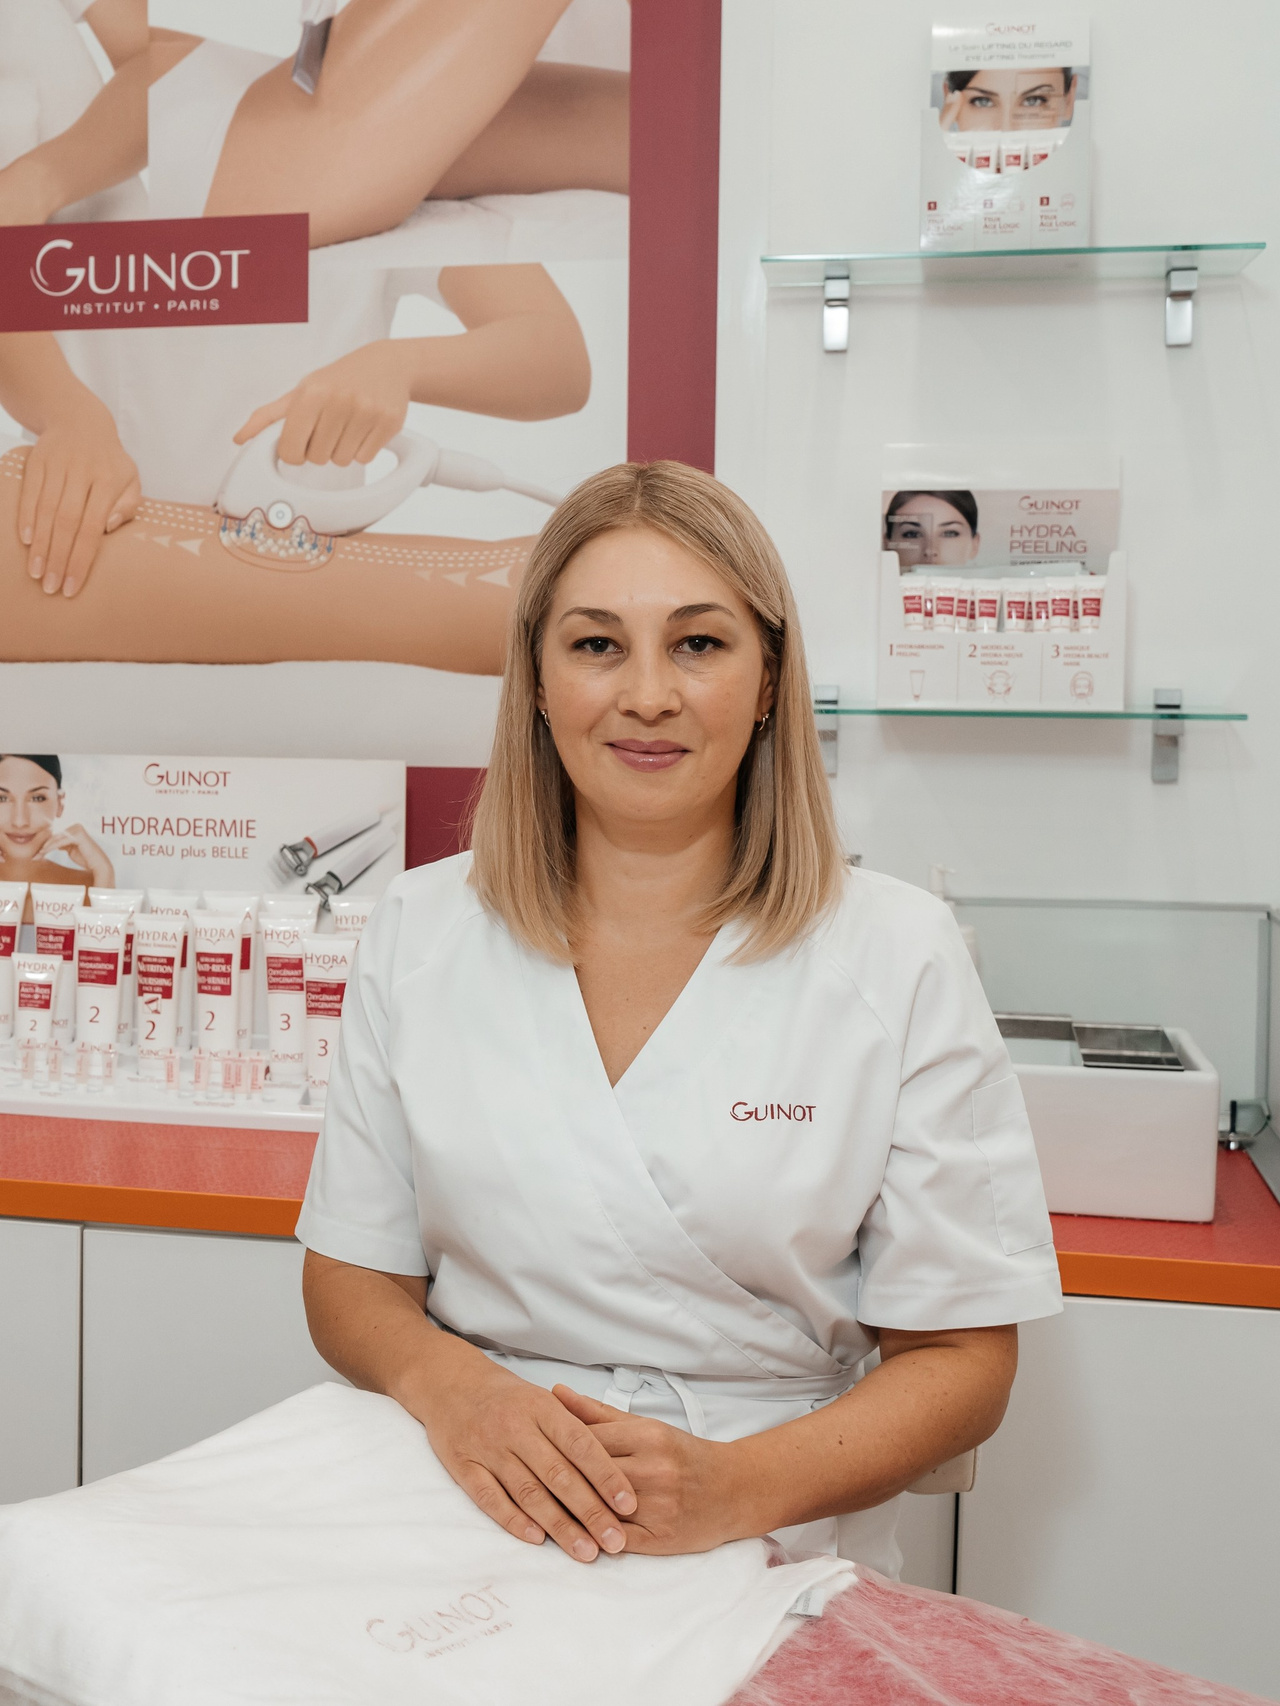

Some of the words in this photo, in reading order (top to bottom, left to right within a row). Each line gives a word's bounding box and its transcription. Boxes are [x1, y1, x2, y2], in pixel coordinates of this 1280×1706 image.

[30, 239, 251, 297] GUINOT
[64, 301, 146, 316] INSTITUT
[167, 299, 220, 313] PARIS
[1019, 495, 1081, 511] GUINOT
[1010, 524, 1077, 538] HYDRA
[1009, 539, 1087, 554] PEELING
[968, 643, 977, 658] 2
[1051, 644, 1060, 658] 3
[142, 763, 231, 787] GUINOT
[101, 816, 257, 839] HYDRADERMIE
[122, 844, 136, 856] La
[141, 844, 175, 857] PEAU
[181, 846, 206, 860] plus
[212, 846, 249, 860] BELLE
[335, 915, 367, 925] HYDR
[77, 923, 120, 936] HYDRA
[137, 930, 177, 942] HYDRA
[195, 928, 235, 939] HYDRA
[264, 929, 300, 941] HYDR
[17, 961, 56, 972] HYDRA
[304, 953, 348, 965] HYDRA
[89, 1006, 100, 1023] 2
[205, 1010, 215, 1031] 2
[280, 1013, 291, 1031] 3
[30, 1020, 37, 1031] 2
[145, 1020, 156, 1040] 2
[318, 1039, 328, 1056] 3
[310, 1075, 329, 1087] GUIN
[730, 1101, 816, 1122] GUINOT
[365, 1583, 510, 1652] GUINOT
